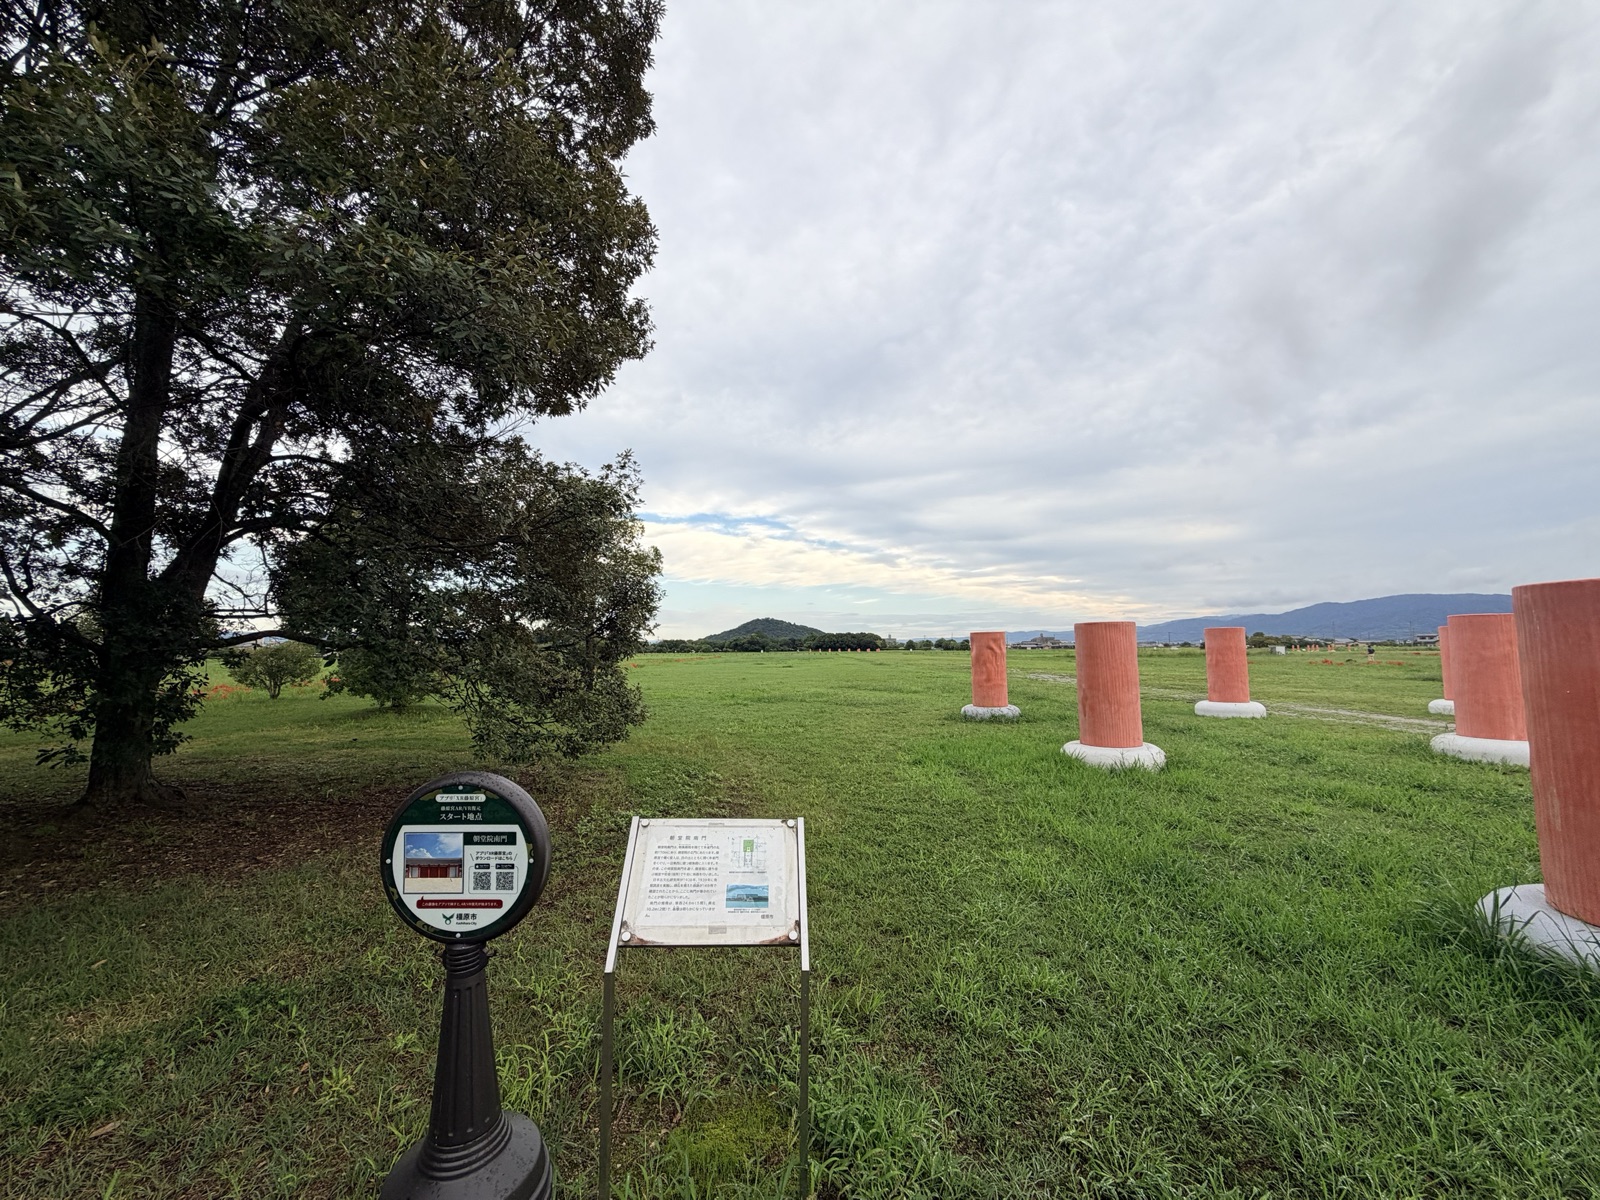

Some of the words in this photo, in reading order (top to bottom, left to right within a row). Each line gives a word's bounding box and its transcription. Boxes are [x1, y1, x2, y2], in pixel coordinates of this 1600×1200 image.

[439, 812, 483, 821] スタート地点
[472, 834, 508, 843] 朝堂院南門
[455, 912, 477, 921] 橿原市
